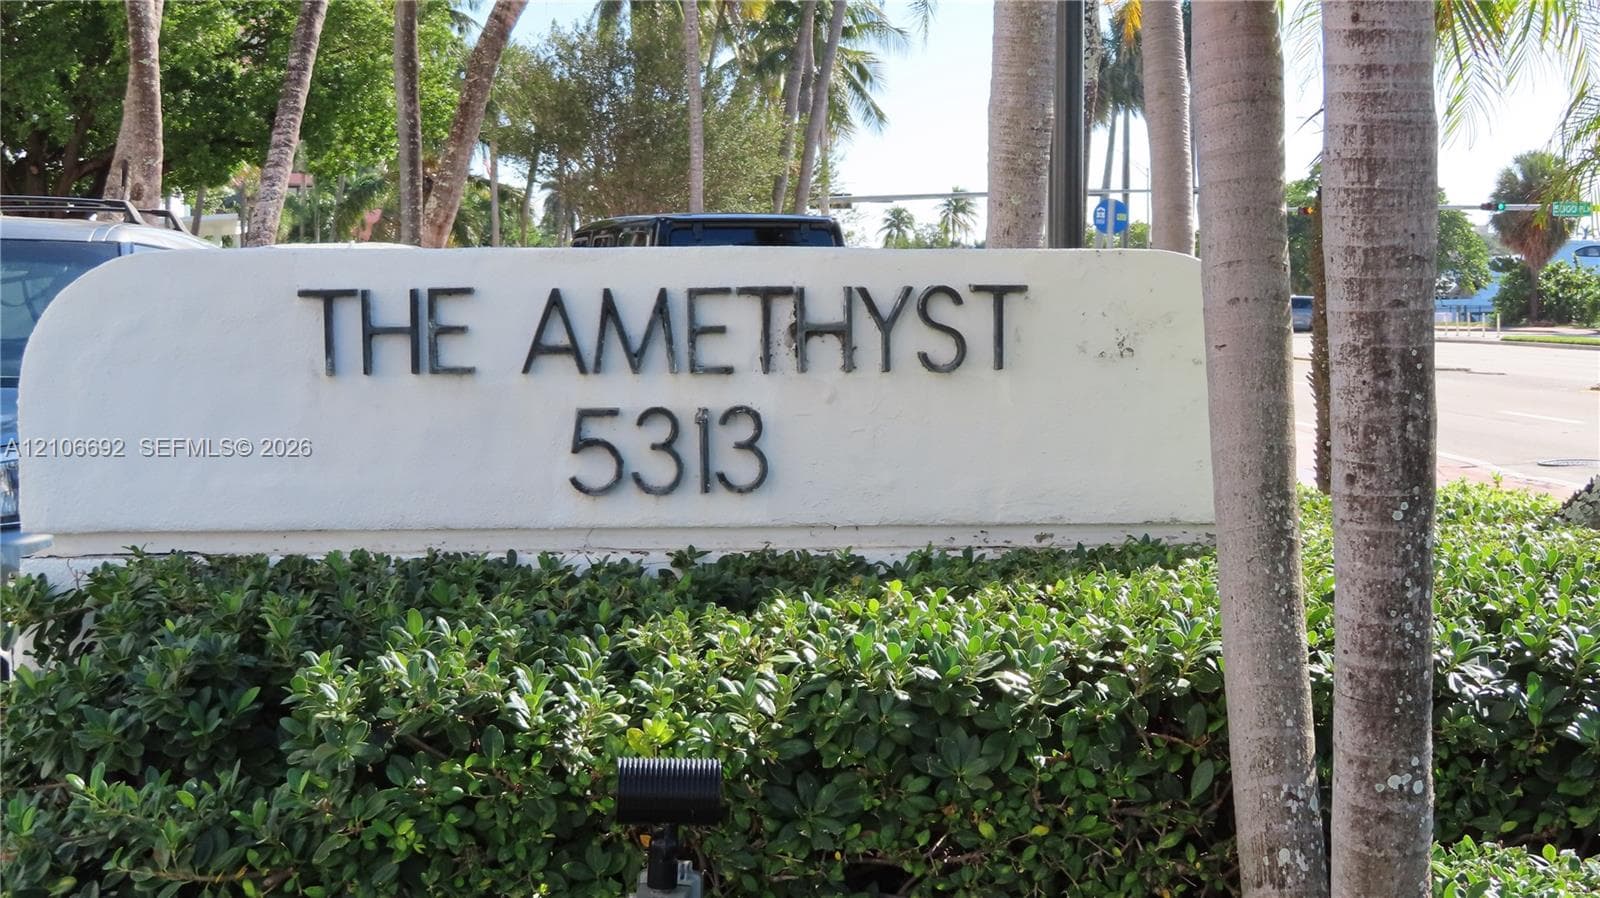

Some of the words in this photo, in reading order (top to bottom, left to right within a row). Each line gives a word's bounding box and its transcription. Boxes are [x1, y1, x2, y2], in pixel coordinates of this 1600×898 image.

[297, 286, 476, 376] THE
[522, 284, 1029, 376] AMETHYST
[569, 406, 769, 497] 5313
